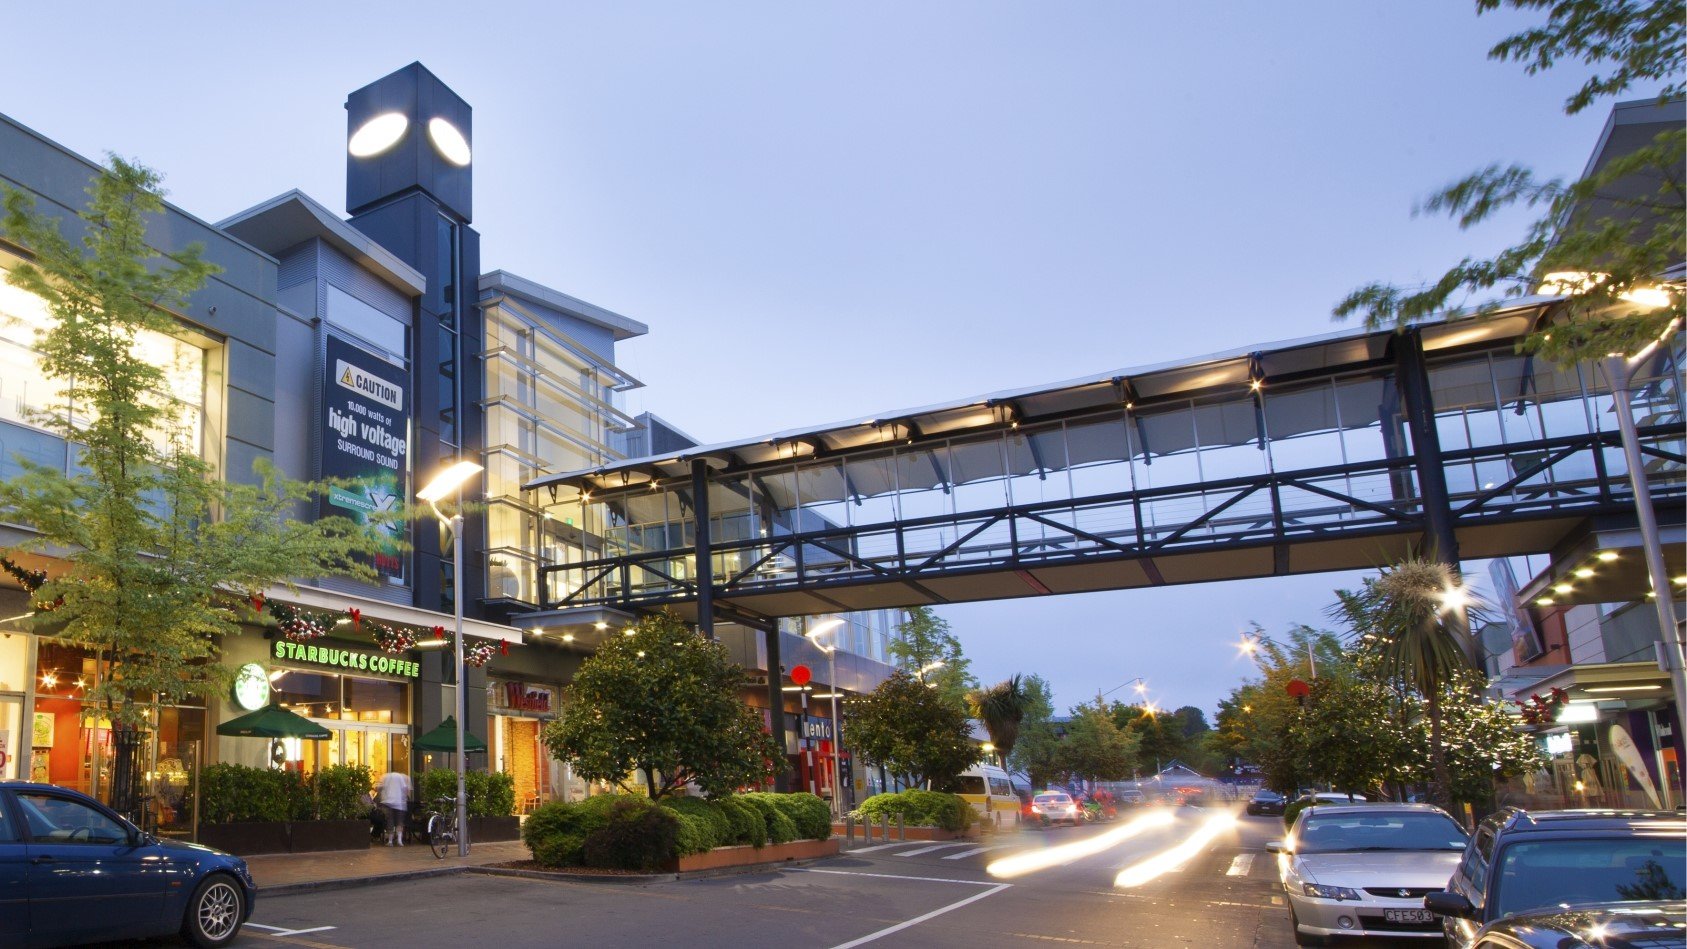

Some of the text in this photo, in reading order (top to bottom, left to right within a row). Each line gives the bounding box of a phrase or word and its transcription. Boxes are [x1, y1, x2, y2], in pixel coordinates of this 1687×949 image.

[356, 374, 397, 404] CAUTION
[328, 407, 406, 457] high voltage
[367, 409, 385, 423] watts
[385, 417, 392, 427] of
[337, 438, 399, 470] SURROUND SOUND
[276, 641, 420, 678] STARBUCKS COFFEE
[506, 681, 550, 713] Westfield
[1386, 910, 1432, 921] CFE503
